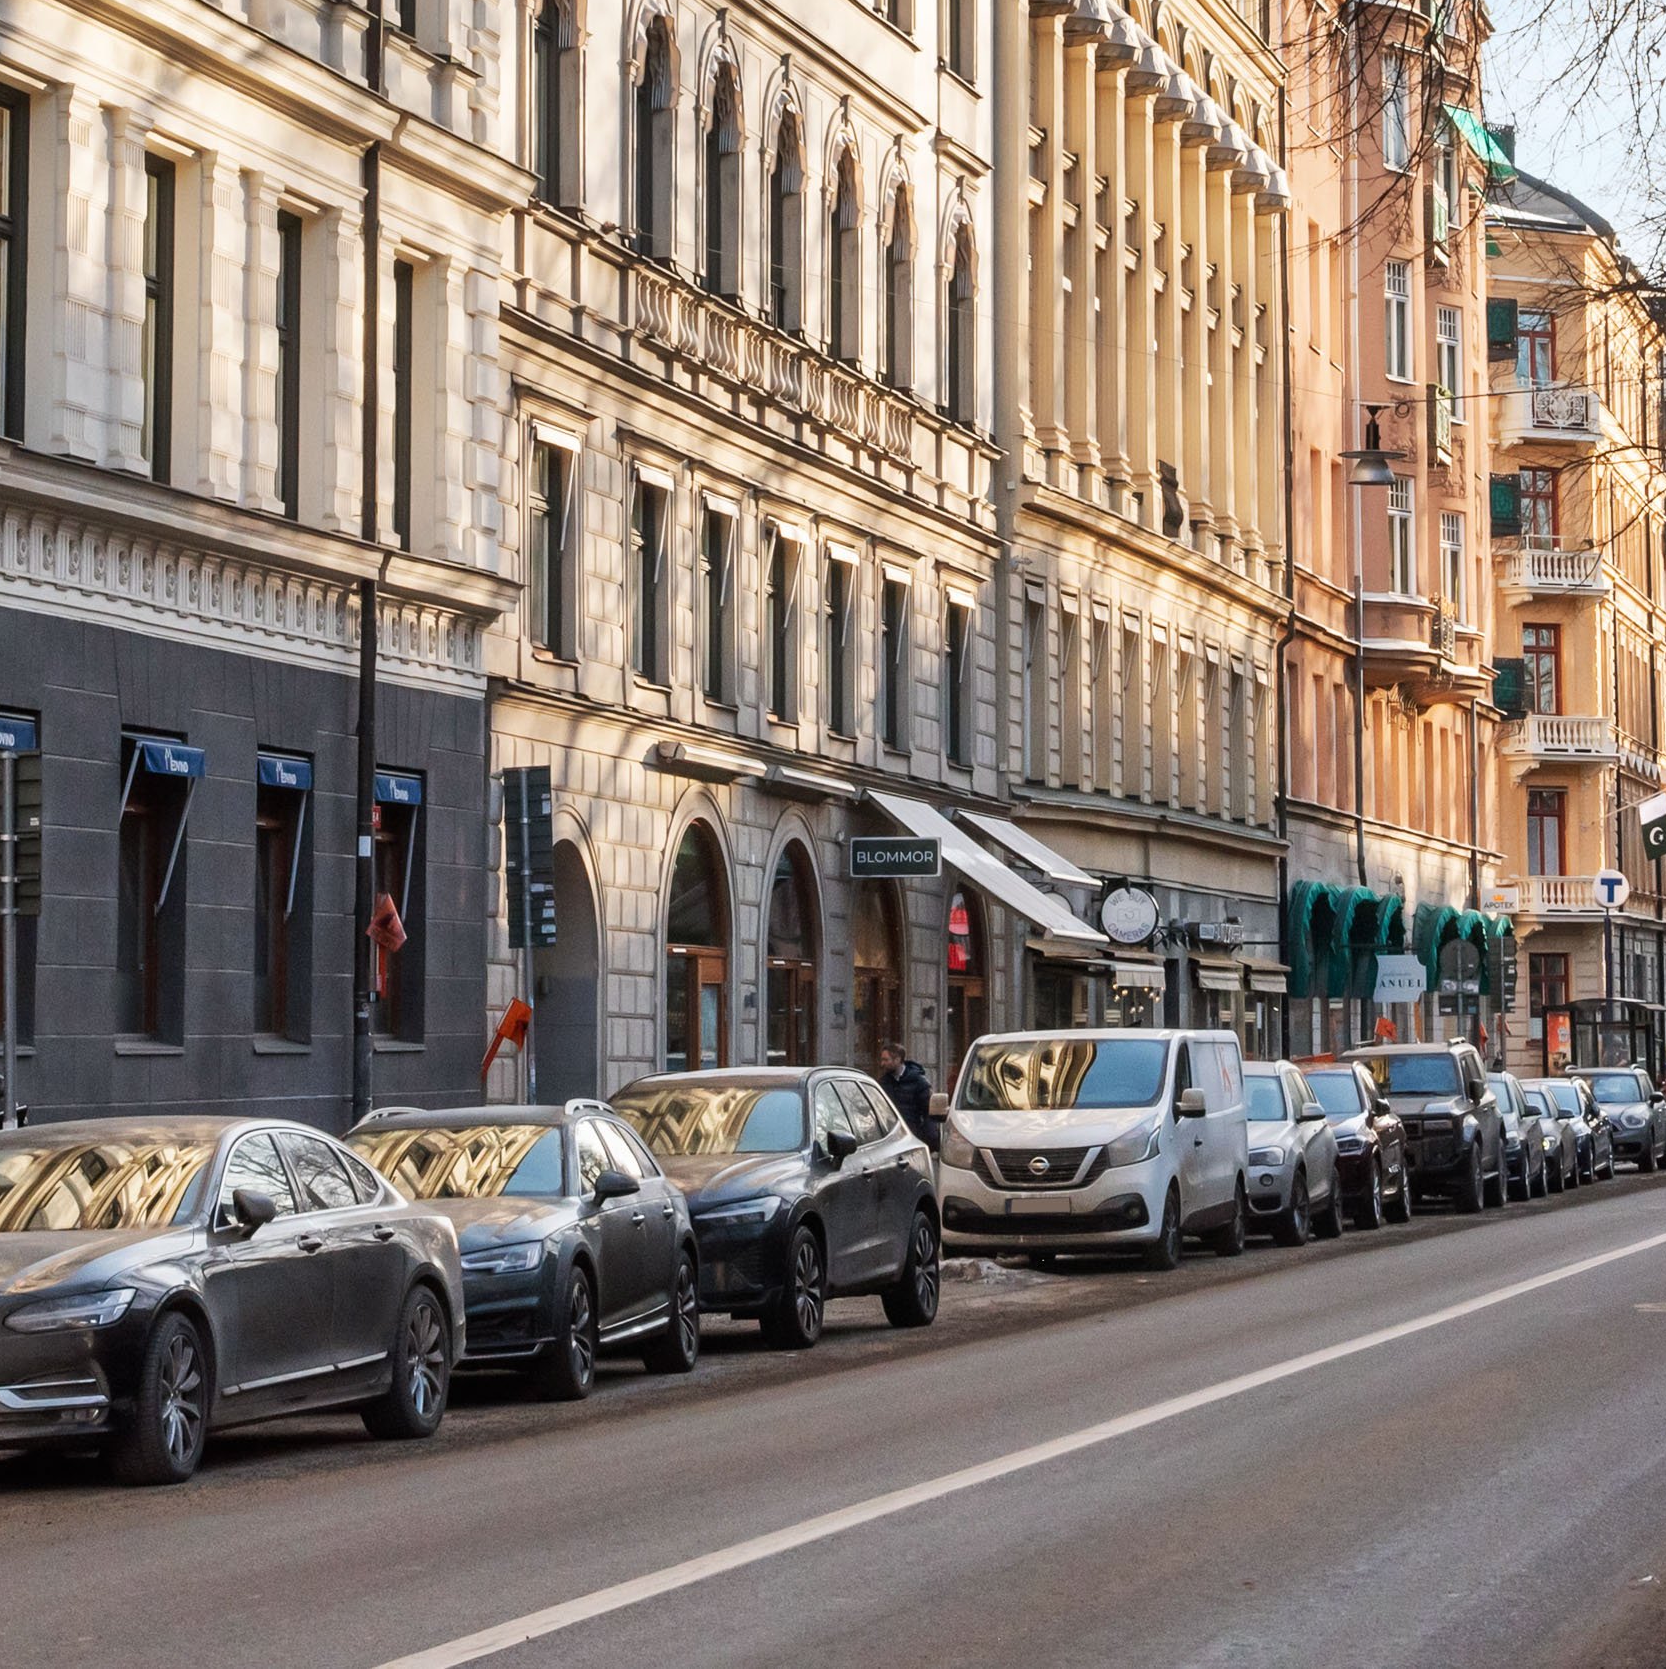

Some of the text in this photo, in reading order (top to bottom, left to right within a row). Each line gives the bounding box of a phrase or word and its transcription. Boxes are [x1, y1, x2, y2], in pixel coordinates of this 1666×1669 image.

[856, 851, 934, 863] BLOMMOR
[1600, 877, 1623, 903] T
[1109, 891, 1149, 907] WE BUY
[1483, 901, 1515, 909] APOTEK
[1107, 922, 1151, 941] CAMERAS
